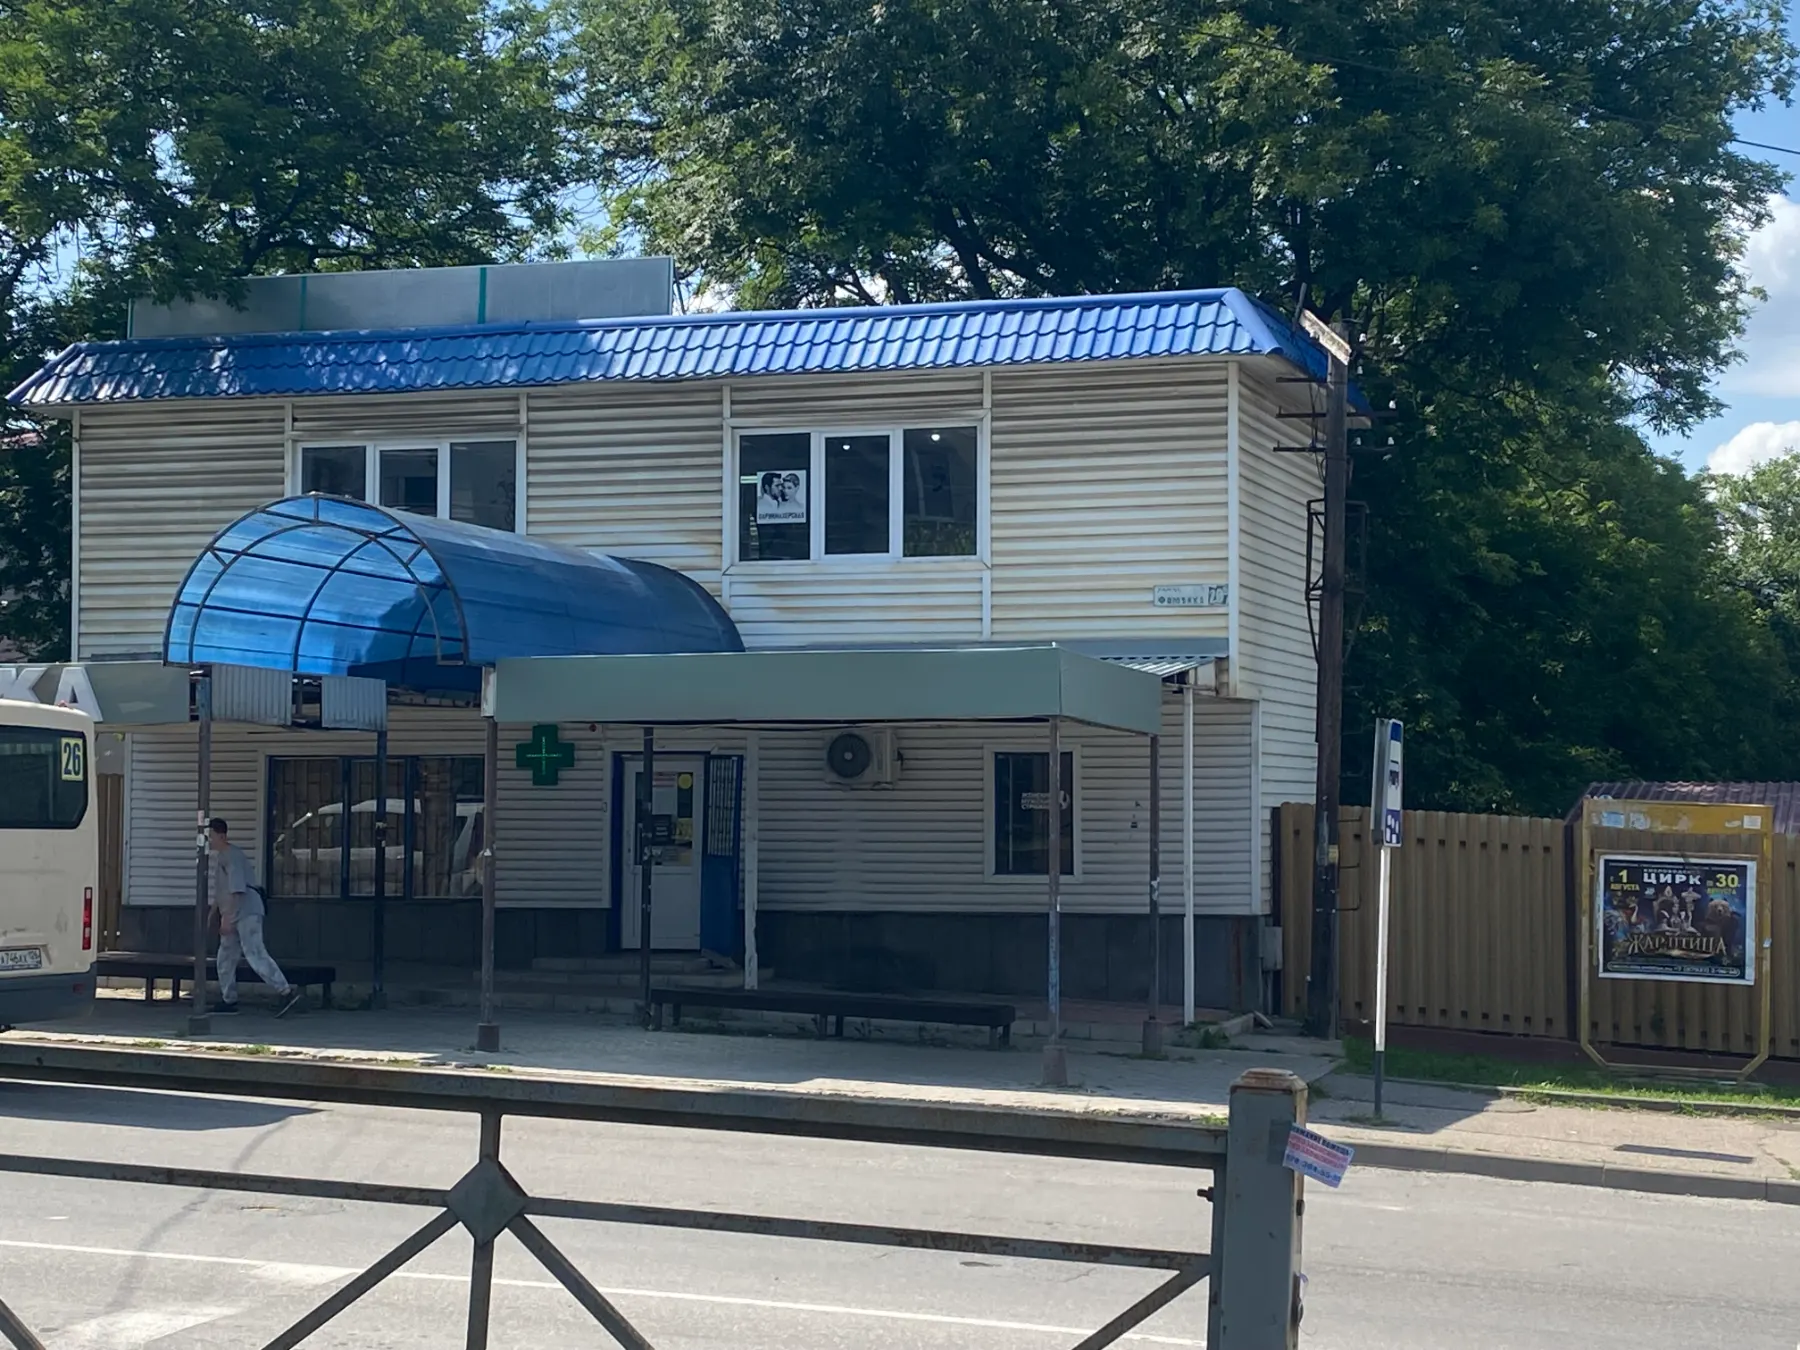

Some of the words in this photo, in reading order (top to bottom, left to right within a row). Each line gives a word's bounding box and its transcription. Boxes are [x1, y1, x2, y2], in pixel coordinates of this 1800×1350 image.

[64, 742, 81, 776] 26
[1618, 869, 1628, 883] 1
[1643, 873, 1701, 885] ЦИРК
[1716, 874, 1739, 888] 30
